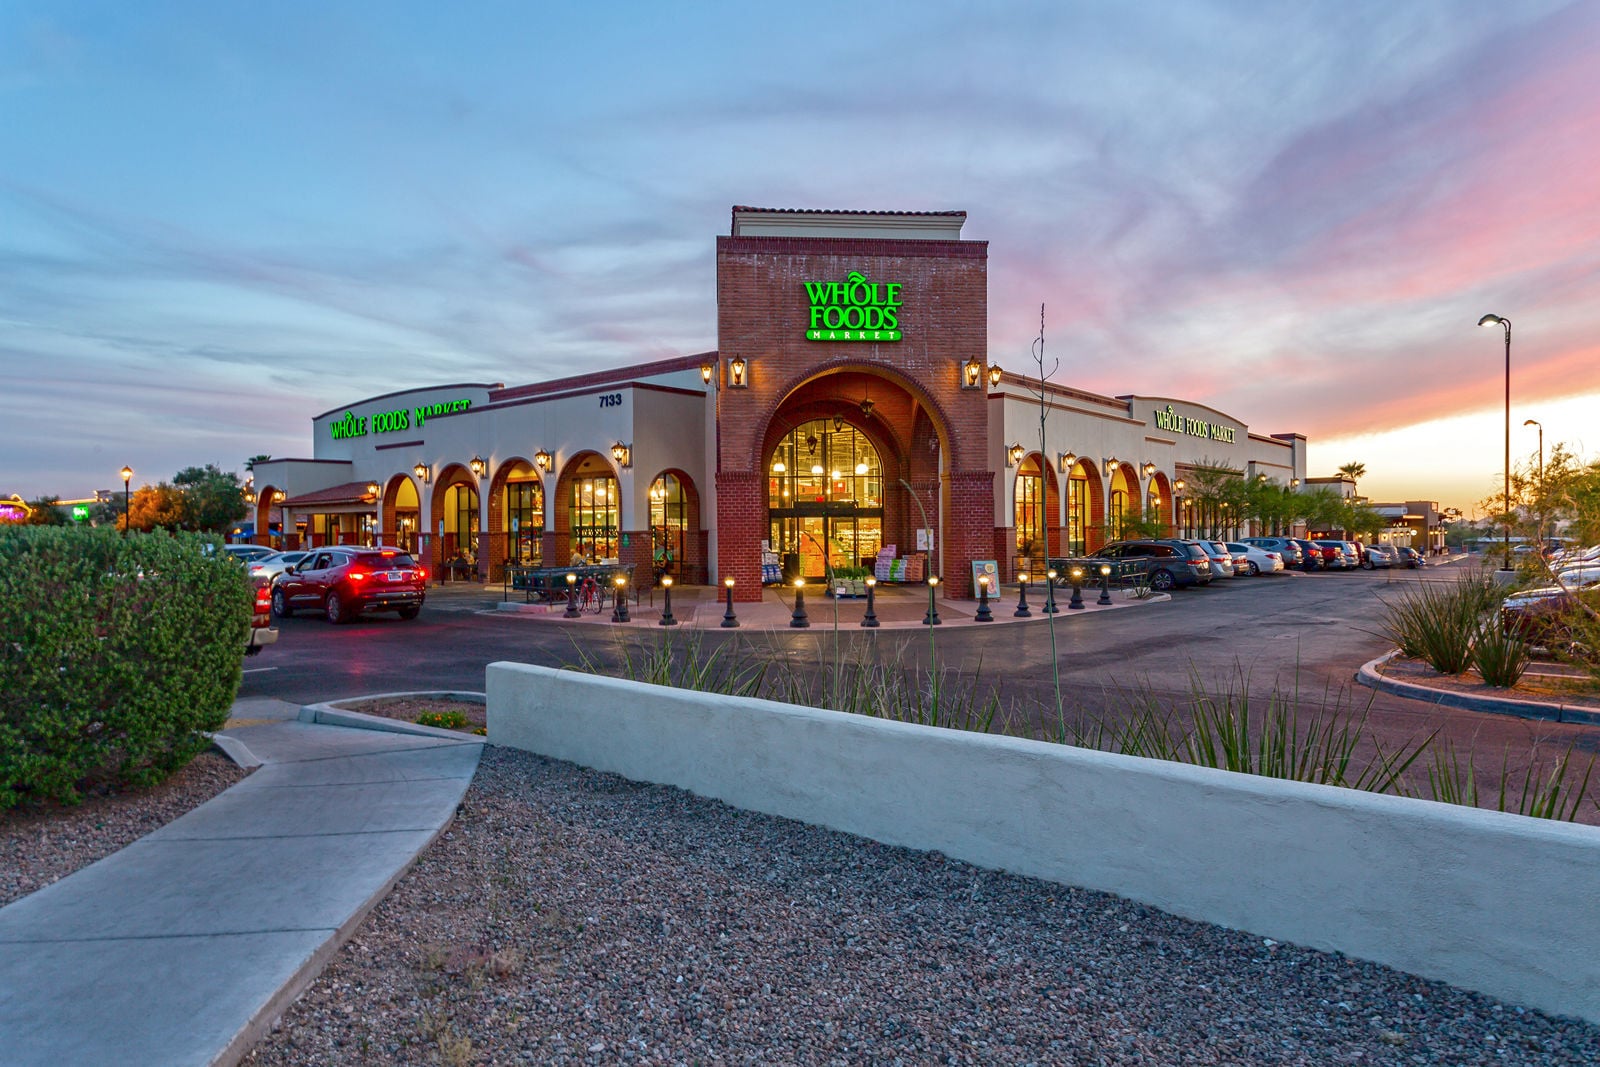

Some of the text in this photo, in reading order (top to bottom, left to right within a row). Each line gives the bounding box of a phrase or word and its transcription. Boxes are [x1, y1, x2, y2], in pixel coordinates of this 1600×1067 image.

[804, 280, 903, 306] WHOLE
[809, 306, 898, 330] FOODS
[813, 331, 895, 339] MARKET
[599, 393, 622, 408] 7133
[330, 411, 367, 439] WHOLE
[372, 409, 409, 433] FOODS
[1155, 408, 1236, 444] WHOLE FOODS MARKET
